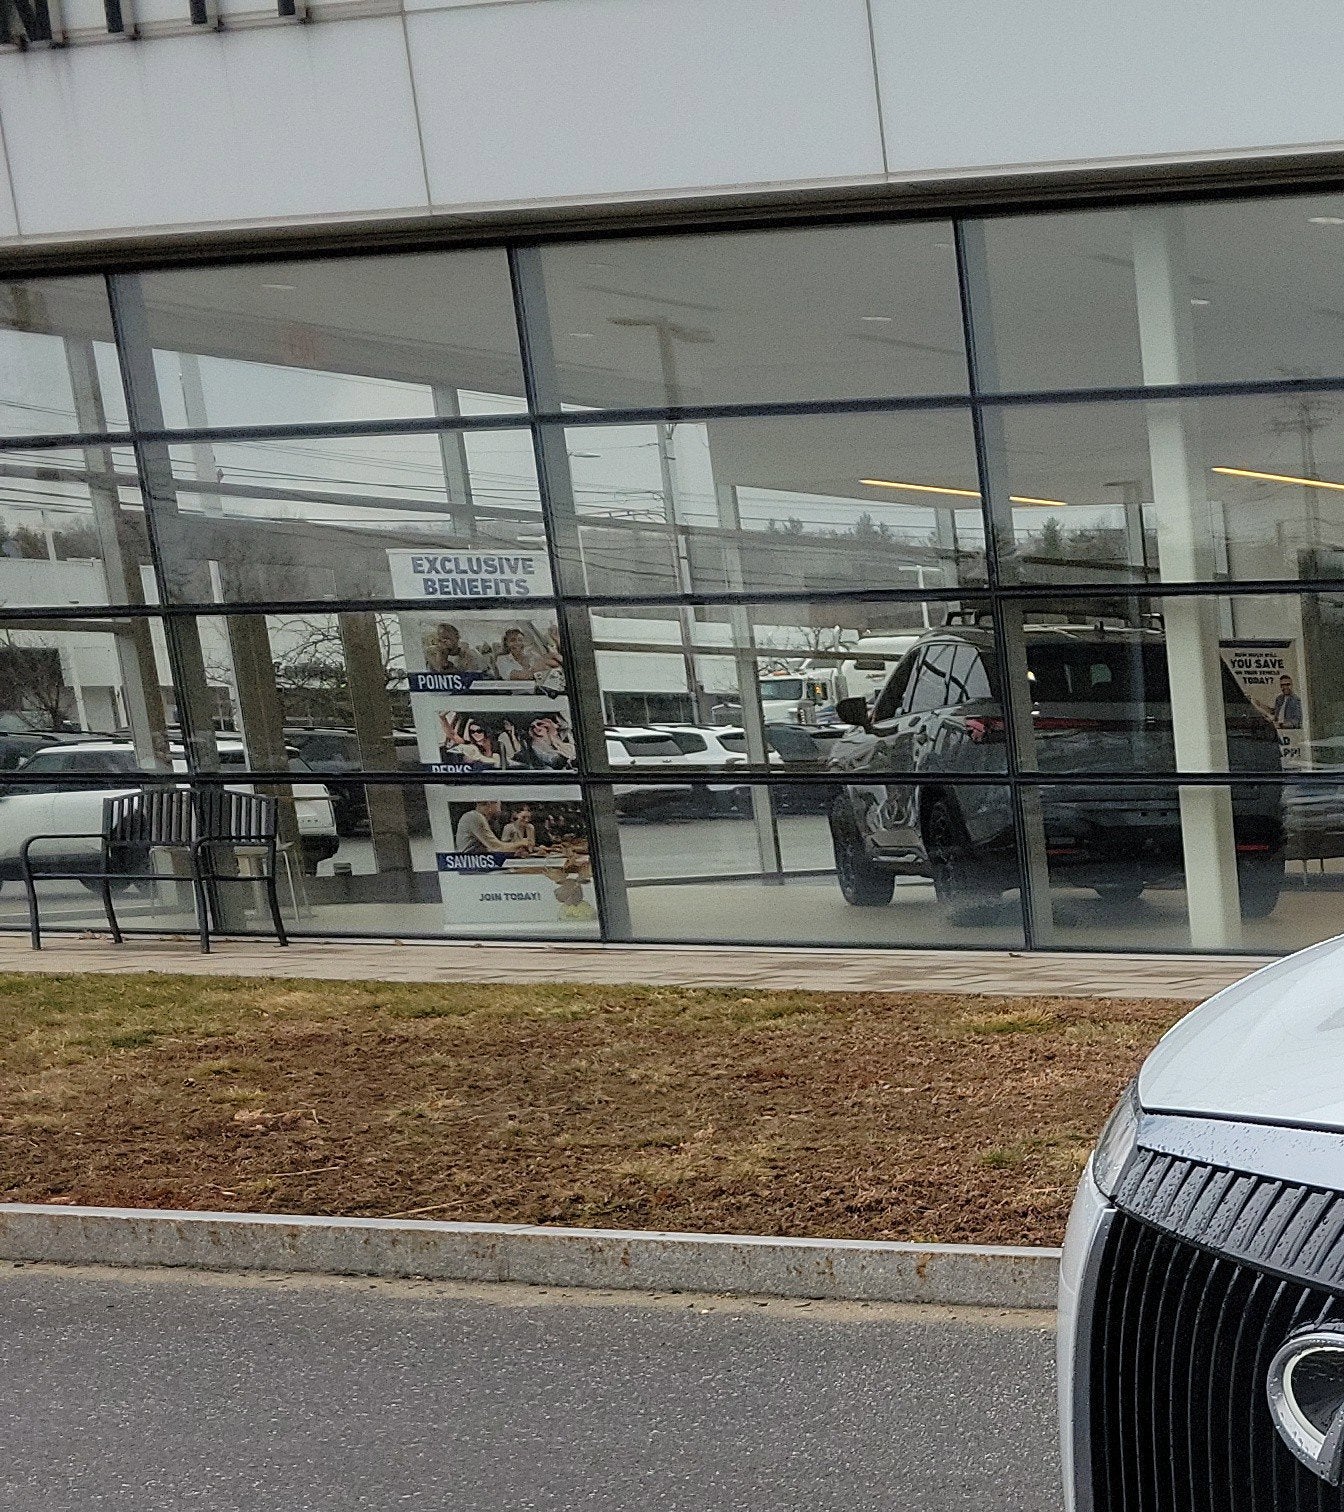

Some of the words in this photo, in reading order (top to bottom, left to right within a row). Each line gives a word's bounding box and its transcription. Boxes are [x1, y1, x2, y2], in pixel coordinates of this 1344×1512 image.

[411, 556, 535, 575] EXCLUSIVE
[422, 577, 530, 596] BENEFITS
[1230, 658, 1252, 669] YOU
[1254, 658, 1285, 669] SAVE
[417, 674, 466, 690] POINTS.
[1242, 676, 1274, 685] TODAY?
[445, 854, 499, 869] SAVINGS.
[479, 892, 502, 901] JOIN
[503, 892, 541, 901] TODAY!
